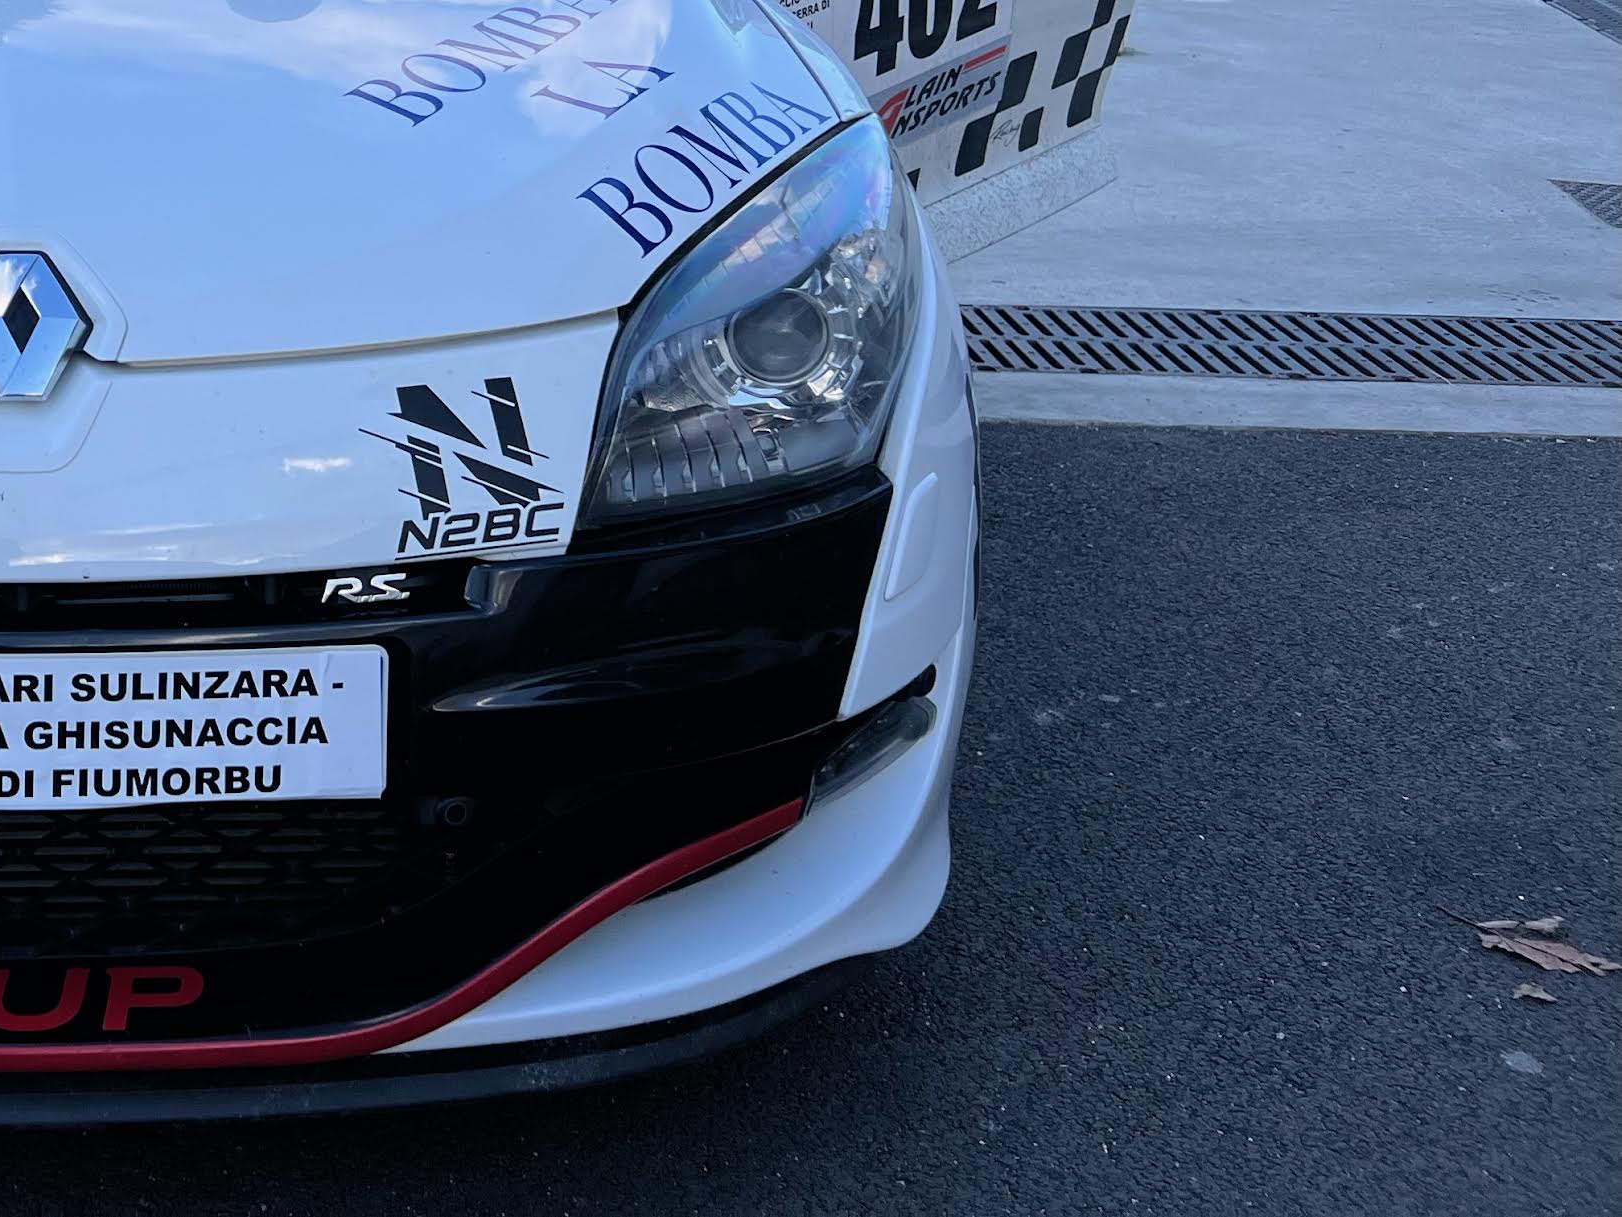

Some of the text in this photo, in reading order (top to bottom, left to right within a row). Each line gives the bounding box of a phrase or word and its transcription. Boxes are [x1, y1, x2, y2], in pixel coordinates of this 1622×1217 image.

[530, 61, 675, 120] LA
[576, 81, 832, 259] BOMBA
[69, 668, 319, 703] SULINZARA
[23, 716, 330, 751] GHISUNACCIA
[51, 764, 282, 798] FIUMORBU
